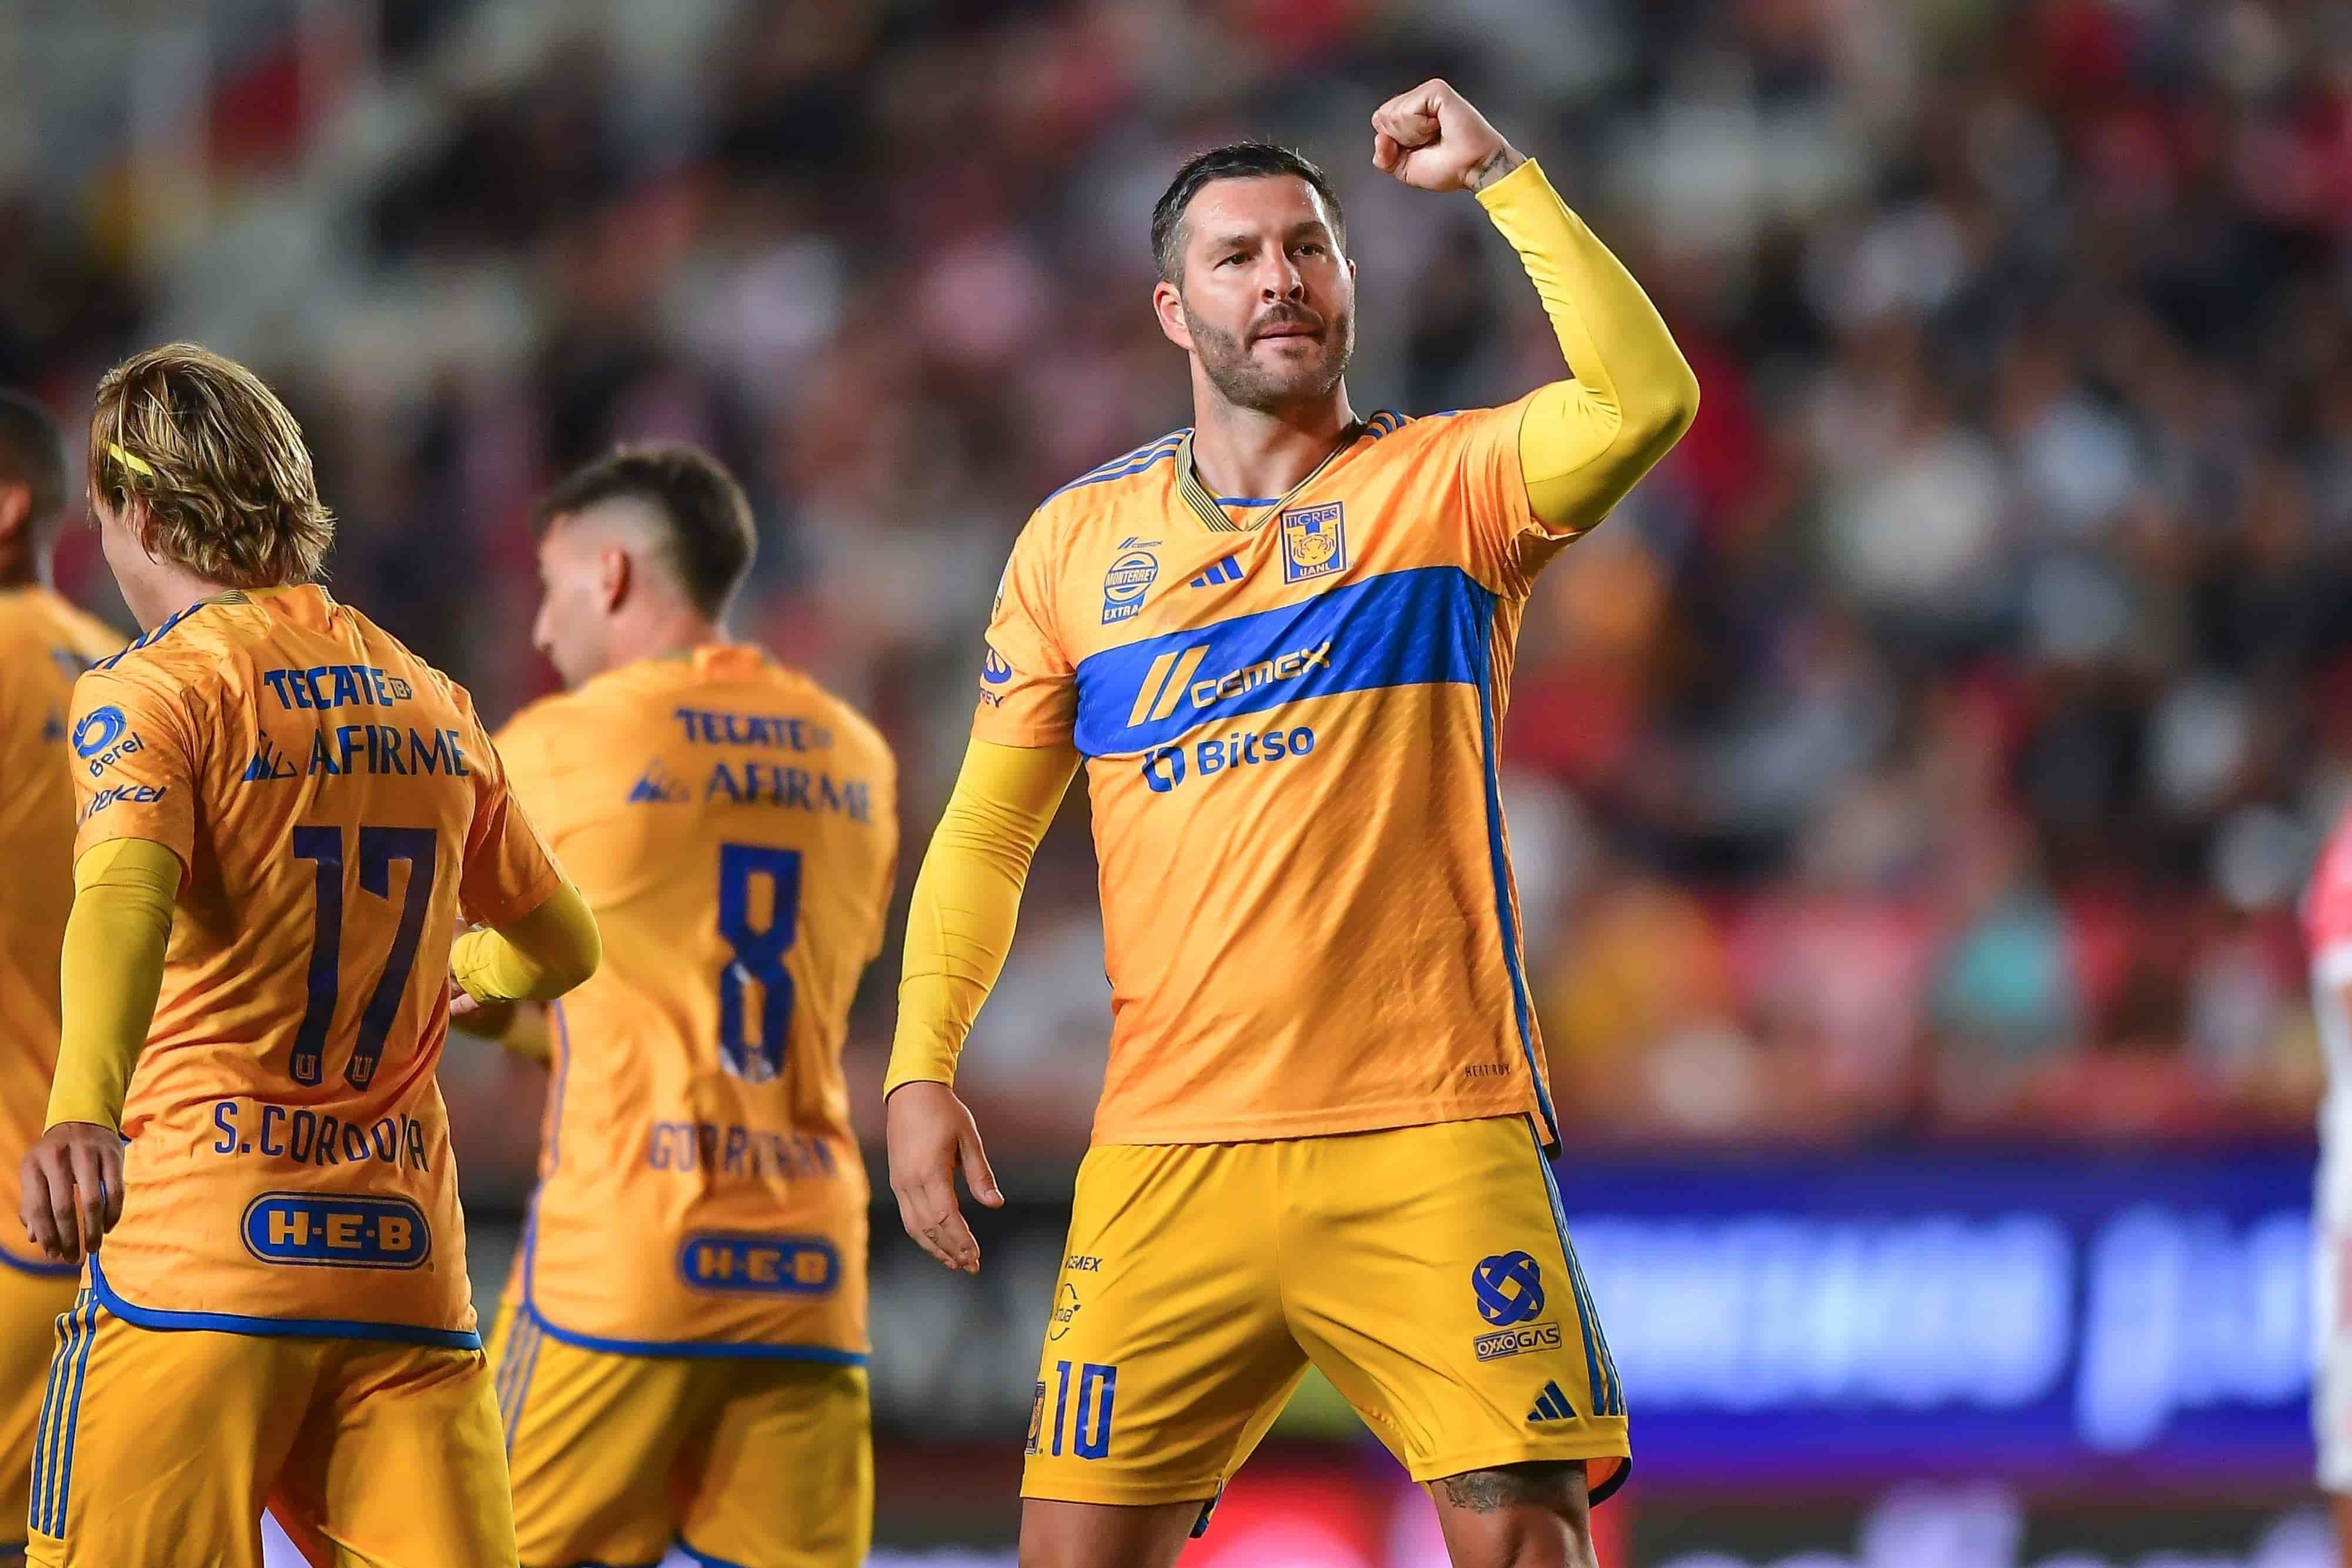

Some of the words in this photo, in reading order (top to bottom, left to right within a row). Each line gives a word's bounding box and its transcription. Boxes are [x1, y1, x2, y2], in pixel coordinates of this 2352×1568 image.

[1287, 508, 1338, 527] TIGRES
[1299, 562, 1331, 576] UANL
[1103, 604, 1139, 620] EXTRA
[263, 665, 395, 710] TECATE
[1190, 641, 1331, 709] CEMEX
[308, 725, 470, 777] AFIRME
[1197, 726, 1314, 776] Bitso
[289, 826, 436, 1092] 17
[719, 843, 802, 1083] 8
[1051, 1360, 1117, 1459] 10
